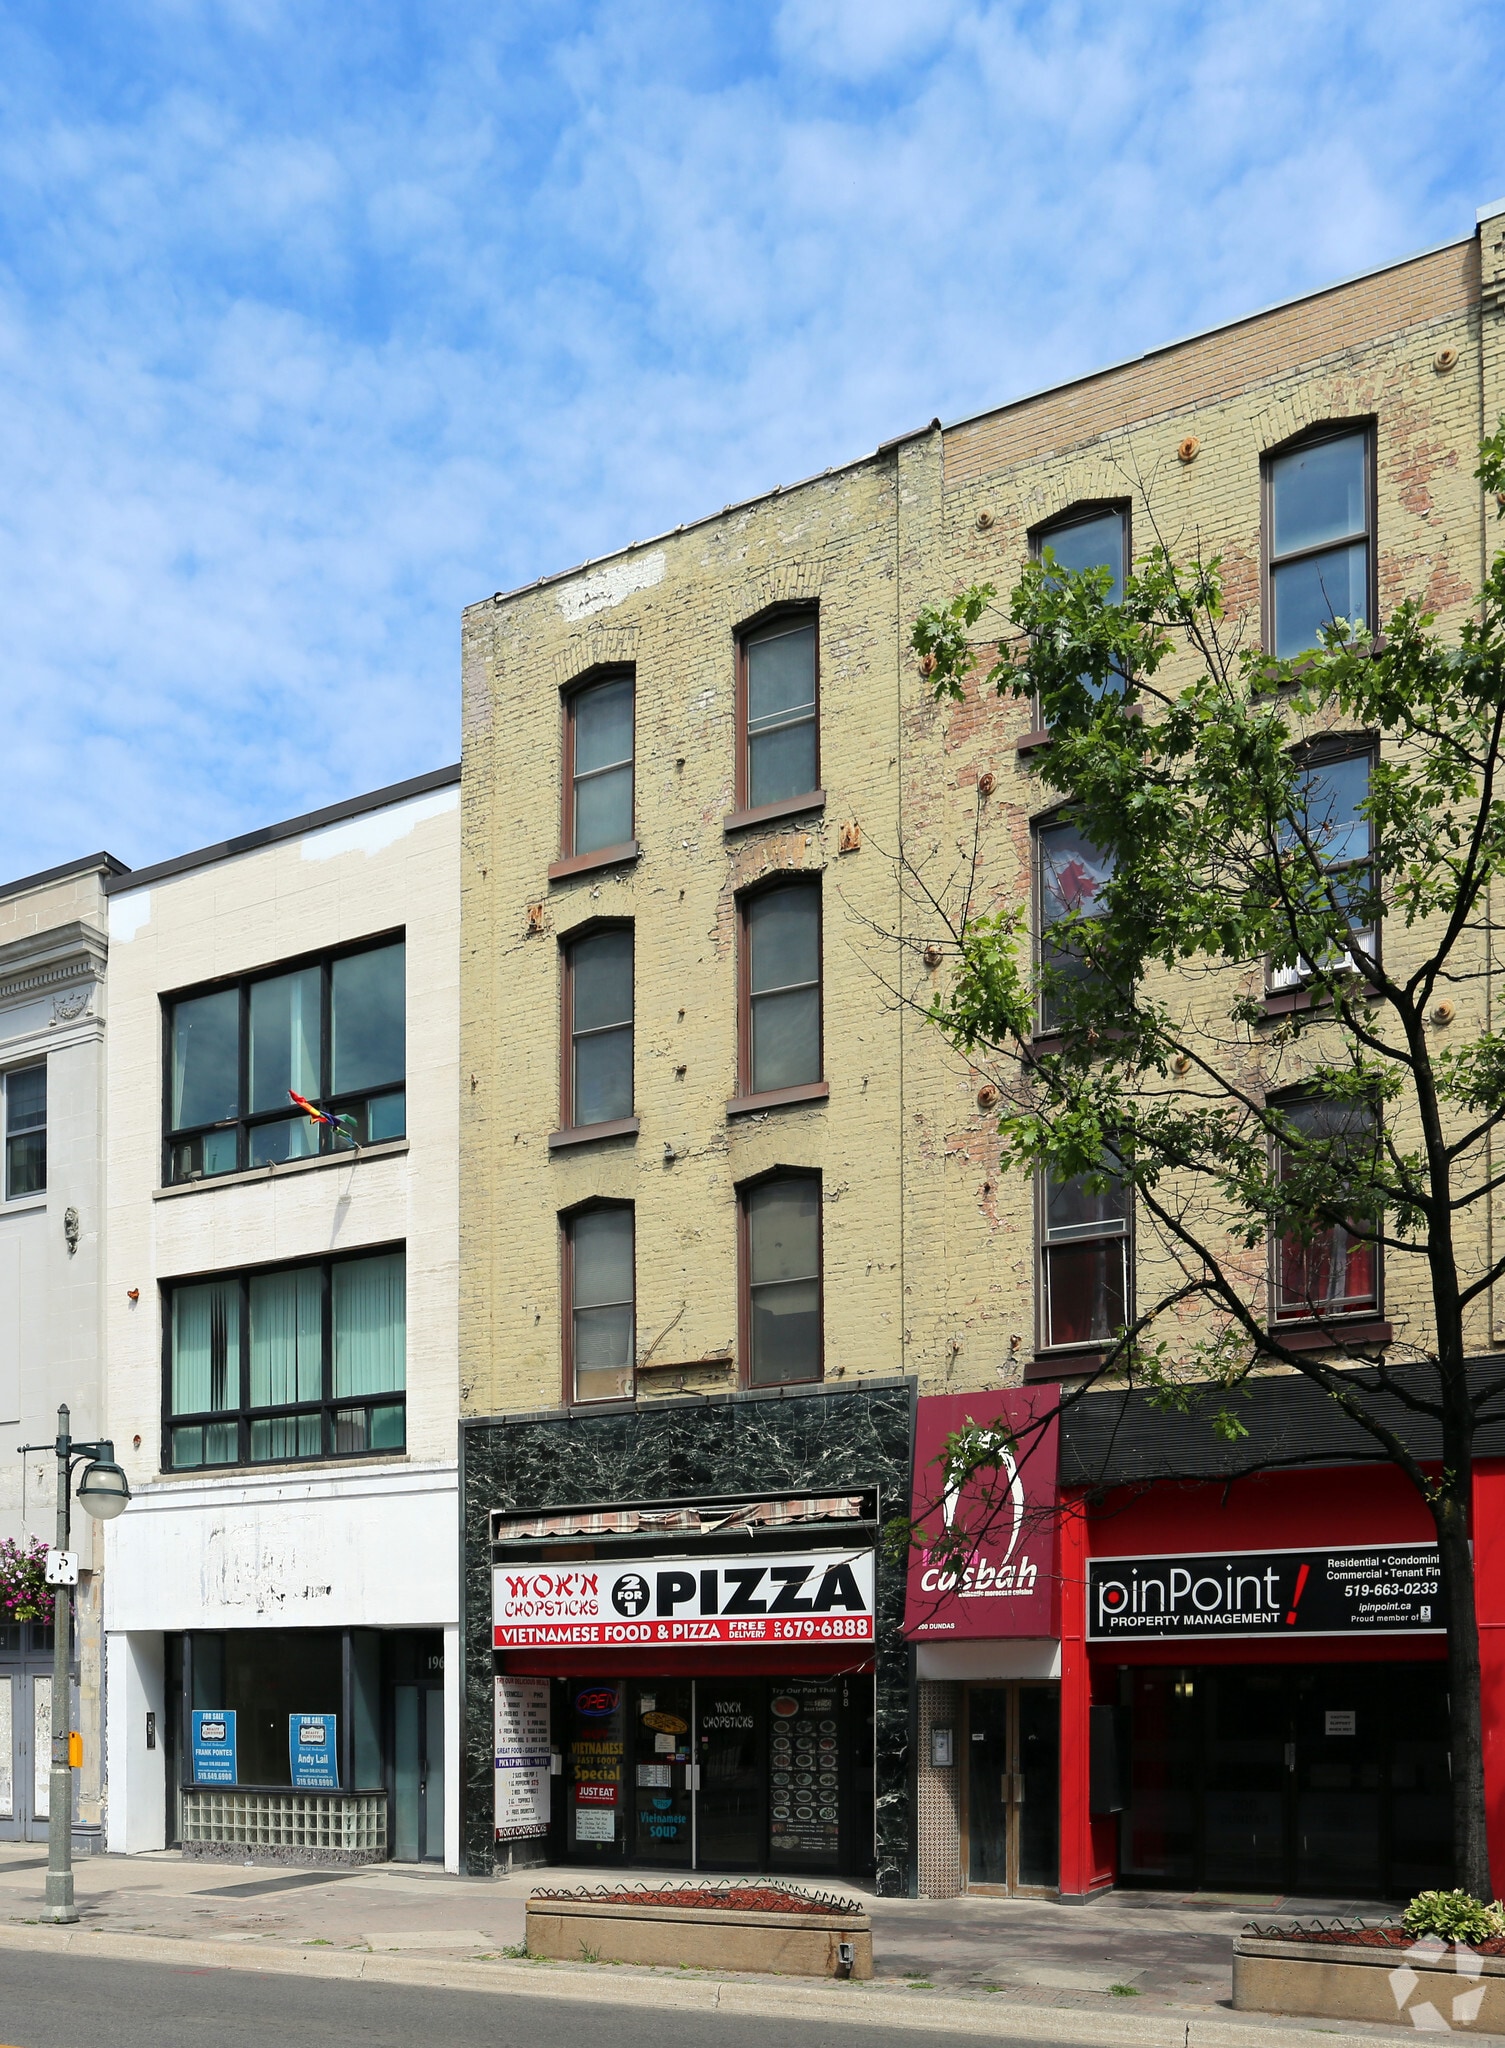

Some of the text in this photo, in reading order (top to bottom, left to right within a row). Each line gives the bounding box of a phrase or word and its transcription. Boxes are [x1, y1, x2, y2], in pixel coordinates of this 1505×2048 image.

[1327, 1556, 1380, 1568] Residential
[1326, 1569, 1382, 1580] Commercial
[1390, 1567, 1424, 1578] Tenant
[505, 1573, 599, 1598] WOK'N
[620, 1575, 641, 1590] 2
[656, 1564, 867, 1617] PIZZA
[1344, 1582, 1438, 1597] 519-663-0233
[617, 1591, 643, 1601] FOR
[504, 1600, 599, 1618] CHOPSTICKS
[624, 1602, 637, 1616] 1
[1358, 1602, 1412, 1613] ipinpoint.ca
[1110, 1612, 1281, 1627] PROPERTY MANAGEMENT
[1376, 1614, 1409, 1622] member
[1411, 1613, 1420, 1621] of
[728, 1621, 766, 1631] FREE
[929, 1622, 956, 1630] DUNDAS
[501, 1623, 721, 1644] VIETNAMESE FOOD & PIZZA
[728, 1630, 766, 1639] DELIVERY
[772, 1687, 785, 1695] Try
[577, 1693, 620, 1709] OPEN
[202, 1712, 224, 1720] FOR SALE
[301, 1716, 324, 1724] FOR SALE
[702, 1715, 754, 1728] CHOPSTICKS
[195, 1748, 233, 1757] FRANK PONTES
[525, 1746, 538, 1754] GREAT
[571, 1741, 624, 1755] VIETNAMESE
[297, 1753, 329, 1766] Andy Lail
[596, 1755, 617, 1765] FOOD
[574, 1765, 621, 1781] Special
[579, 1786, 615, 1797] JUST EAT
[640, 1811, 687, 1824] Vietnamese
[650, 1826, 677, 1838] SOUP
